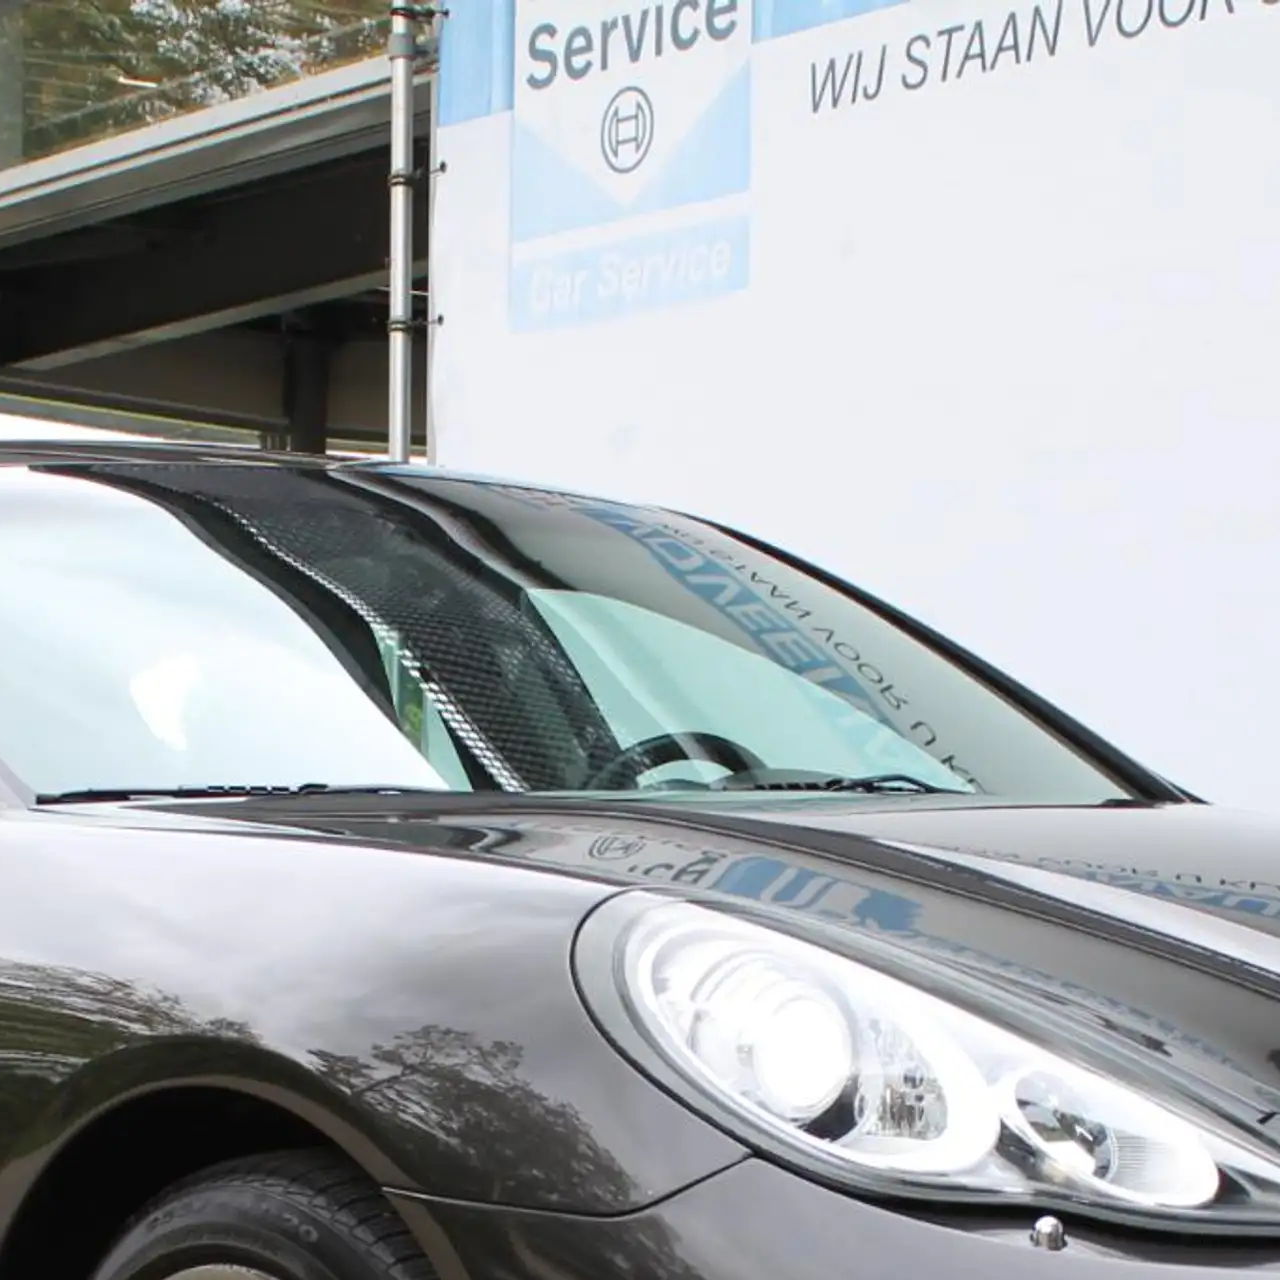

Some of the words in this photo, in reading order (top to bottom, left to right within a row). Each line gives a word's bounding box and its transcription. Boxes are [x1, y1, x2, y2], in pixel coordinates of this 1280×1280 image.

[526, 0, 738, 90] Service
[810, 44, 888, 114] WIJ
[901, 3, 1061, 90] STAAN
[532, 264, 588, 314] Car
[596, 240, 732, 300] Service
